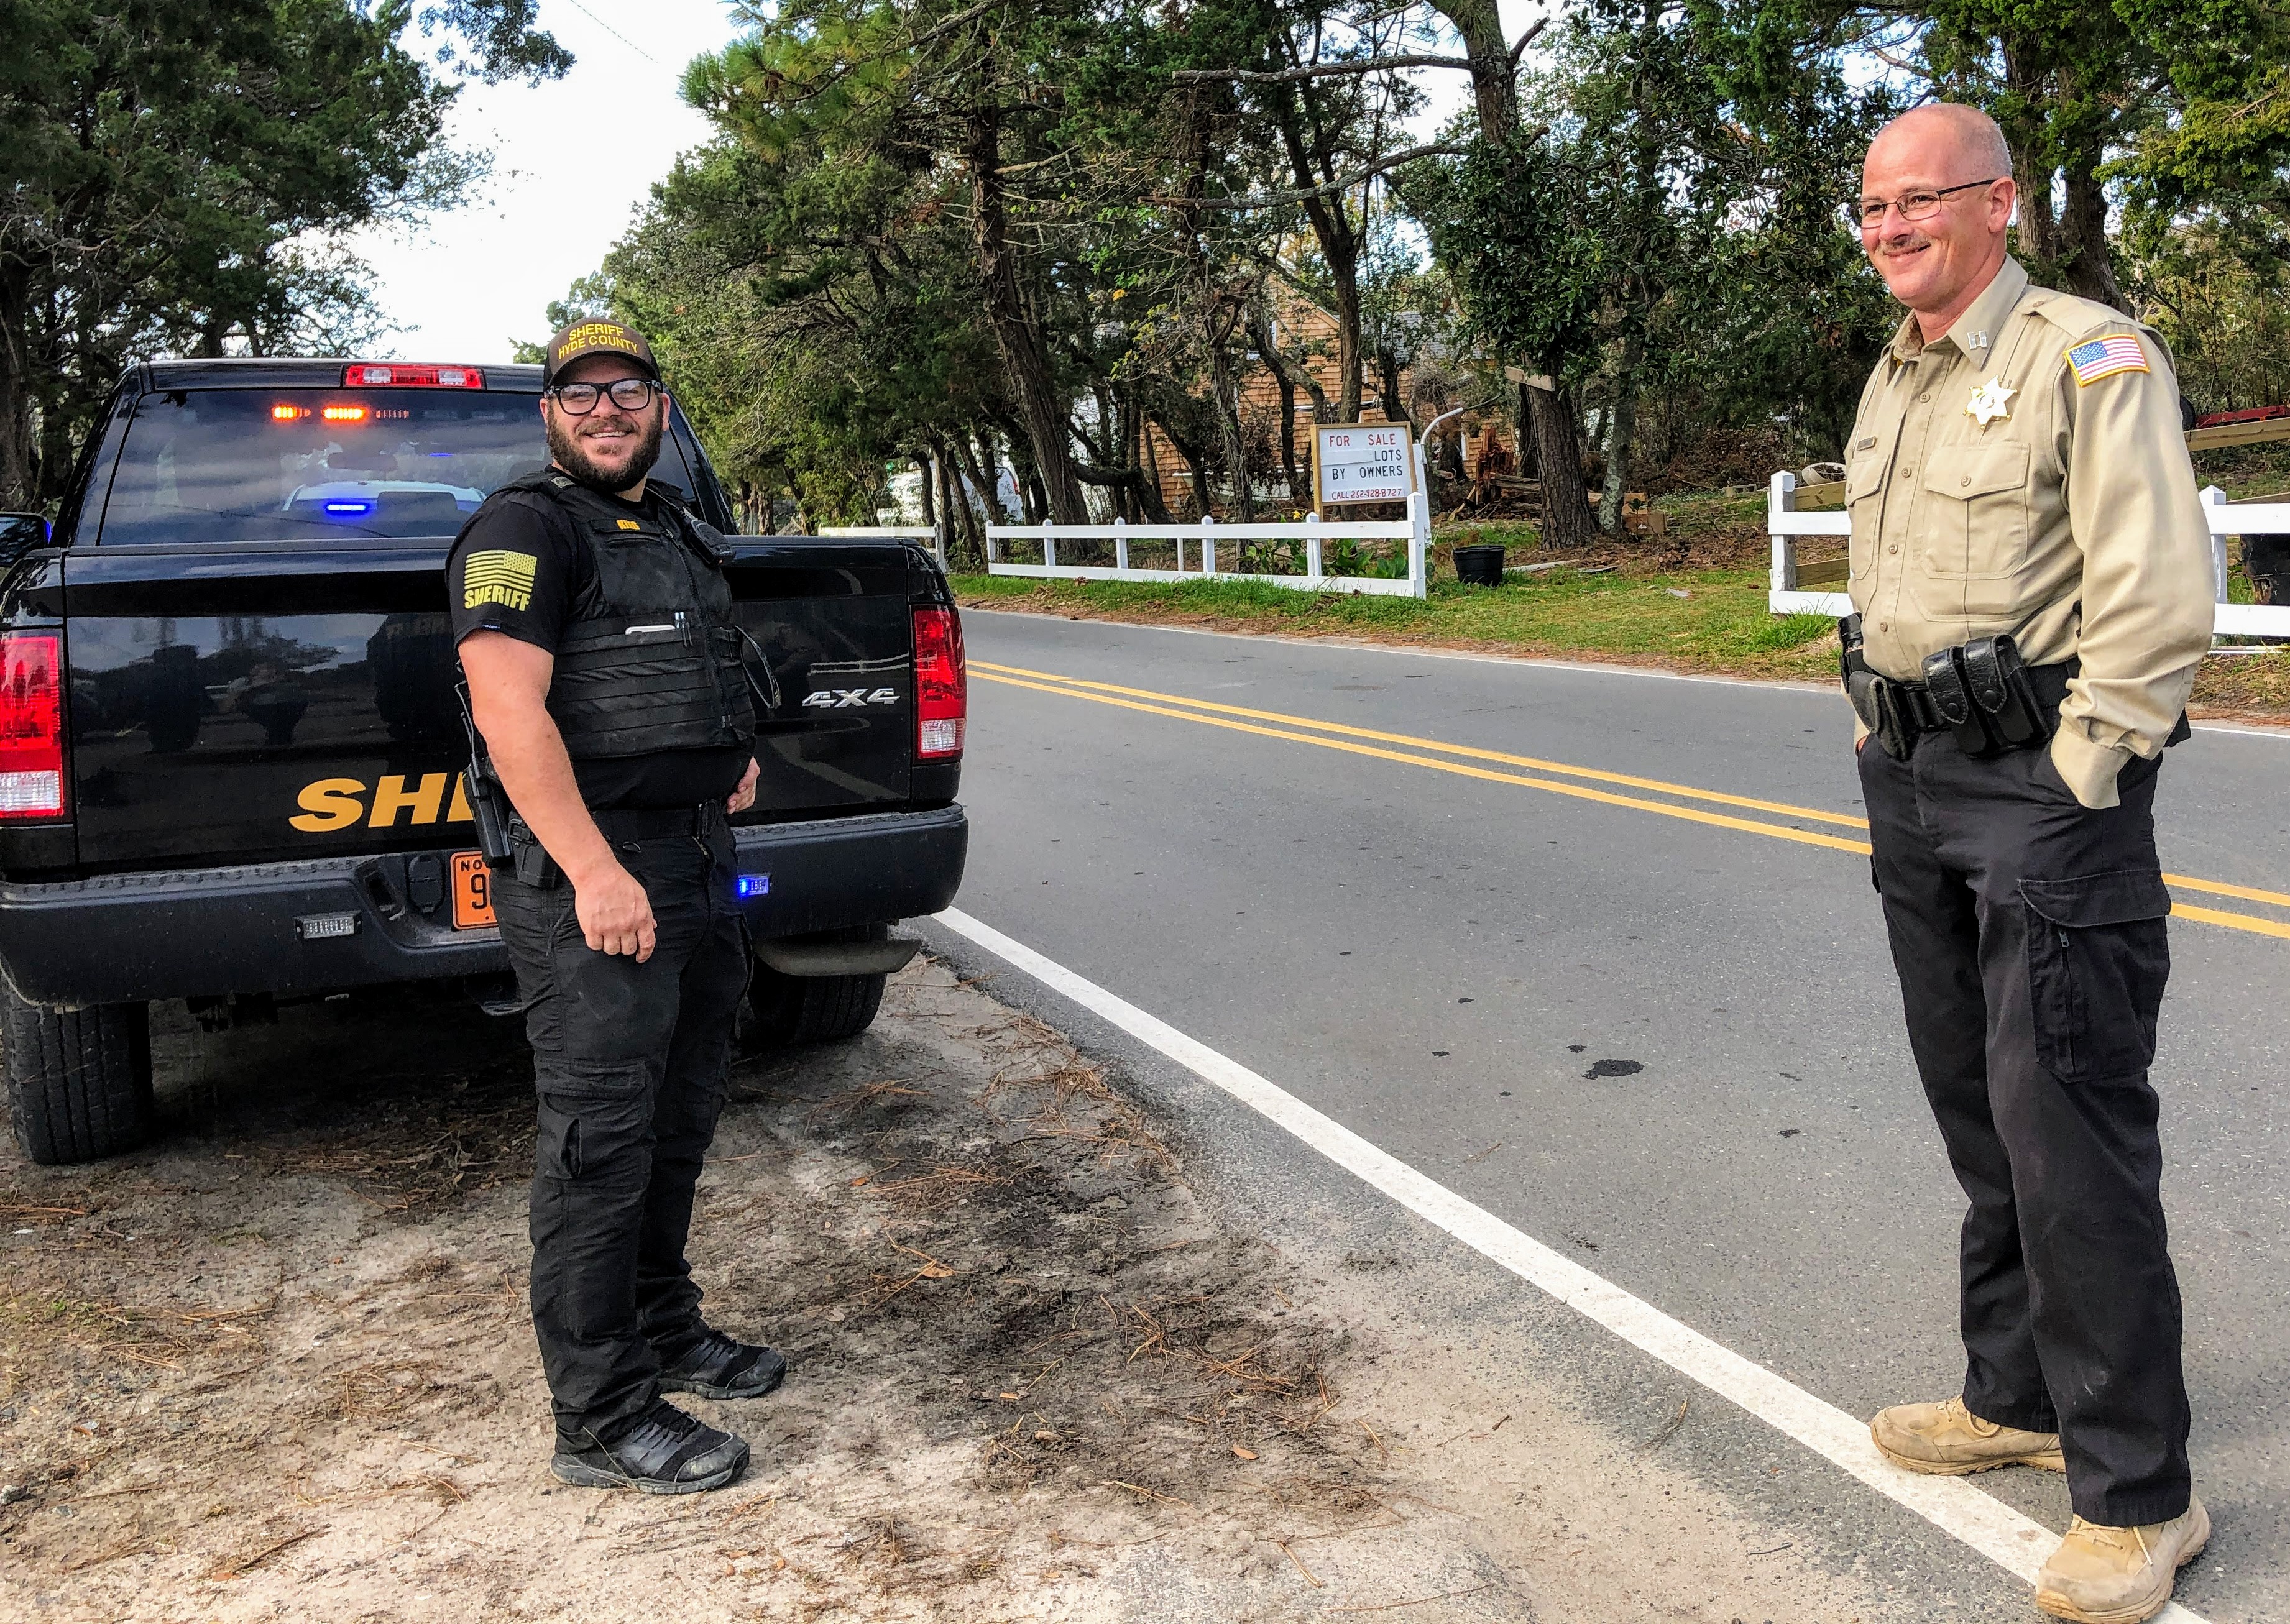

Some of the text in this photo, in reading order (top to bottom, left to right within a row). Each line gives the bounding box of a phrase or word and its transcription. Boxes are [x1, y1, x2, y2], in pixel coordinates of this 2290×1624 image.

[569, 323, 624, 341] SHERIFF
[558, 335, 638, 360] HYDE COUNTY
[1329, 433, 1396, 447] FOR SALE
[1374, 449, 1402, 462] LOTS
[1332, 465, 1403, 480] BY OWNERS
[1331, 488, 1402, 500] CALL 252-928-8727
[464, 585, 531, 612] SHERIFF
[461, 859, 483, 872] NO
[471, 873, 488, 910] 9
